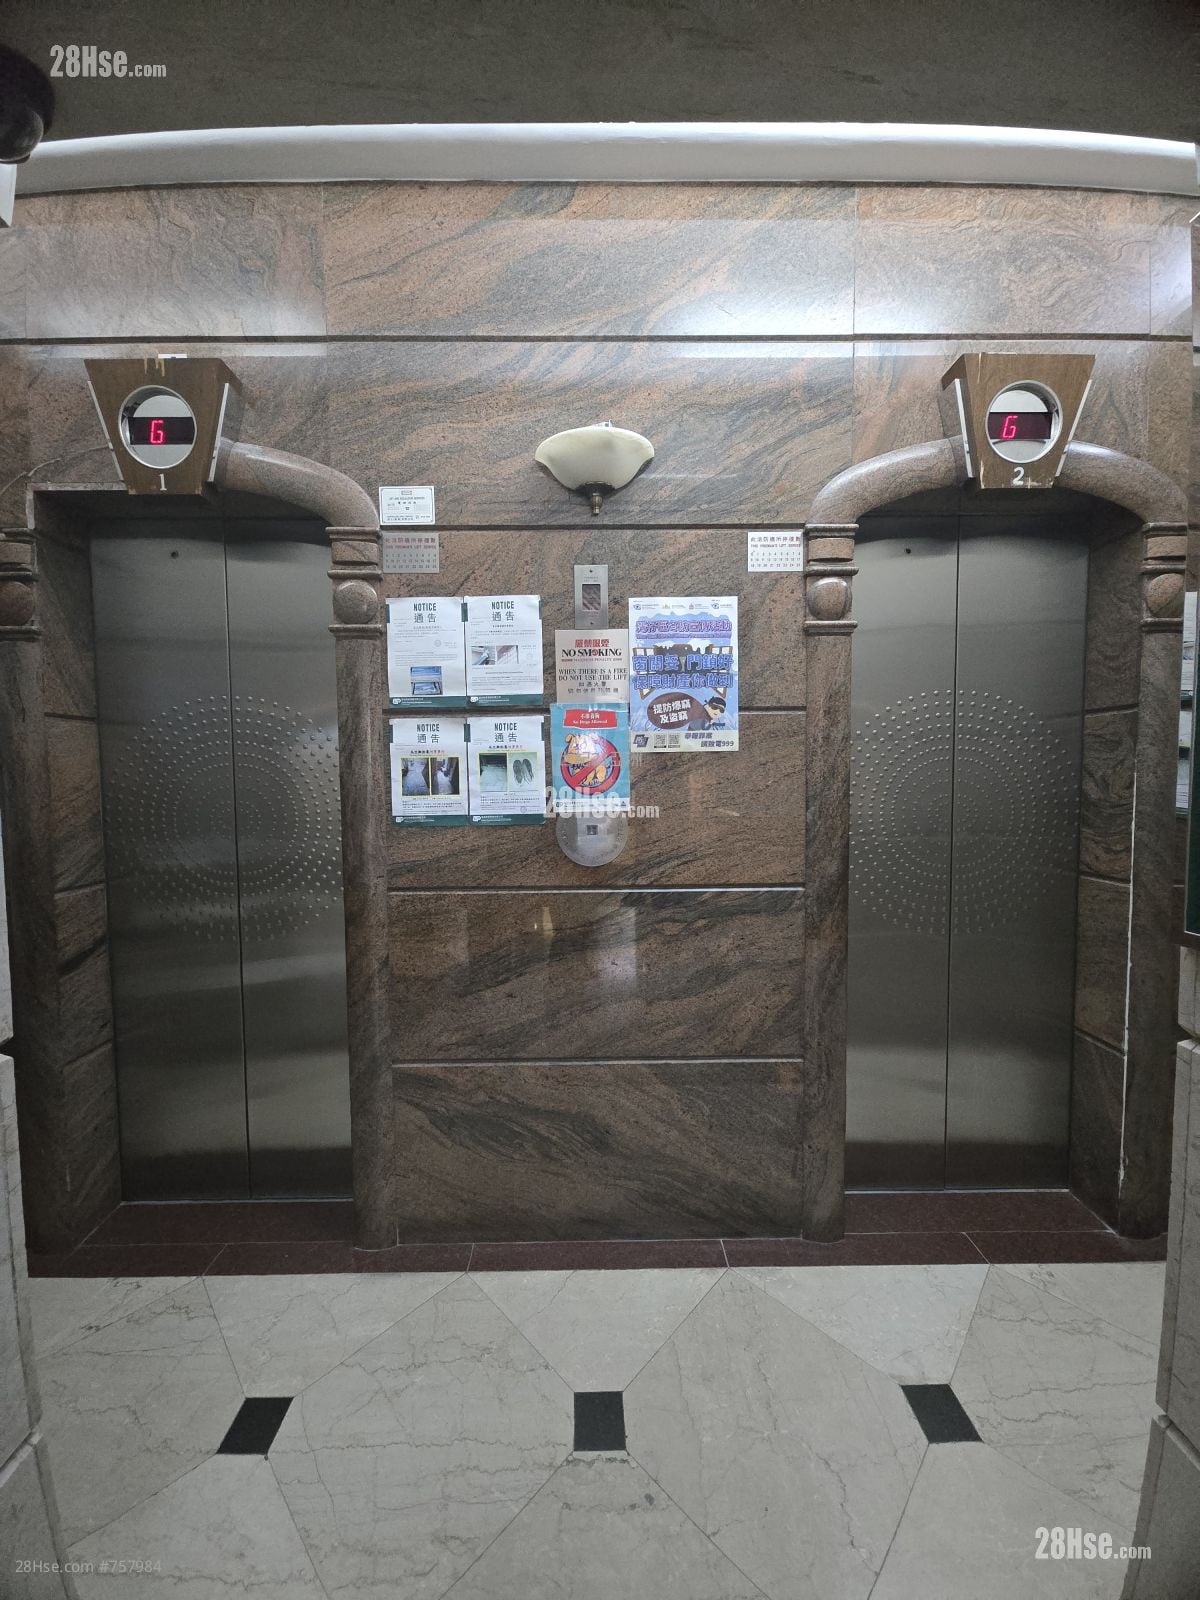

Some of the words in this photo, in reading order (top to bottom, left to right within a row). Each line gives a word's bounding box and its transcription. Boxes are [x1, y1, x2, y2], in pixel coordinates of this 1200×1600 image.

[150, 419, 166, 444] G
[1001, 415, 1018, 440] G
[1012, 466, 1025, 486] 2
[159, 473, 167, 491] 1
[413, 602, 437, 612] NOTICE
[491, 600, 515, 610] NOTICE
[414, 612, 437, 623] 通告
[492, 611, 515, 622] 通告
[562, 649, 576, 657] NO
[686, 653, 733, 670] 門鎖好
[417, 723, 440, 733] NOTICE
[494, 722, 517, 731] NOTICE
[417, 733, 440, 744] 通告
[494, 732, 517, 743] 通告
